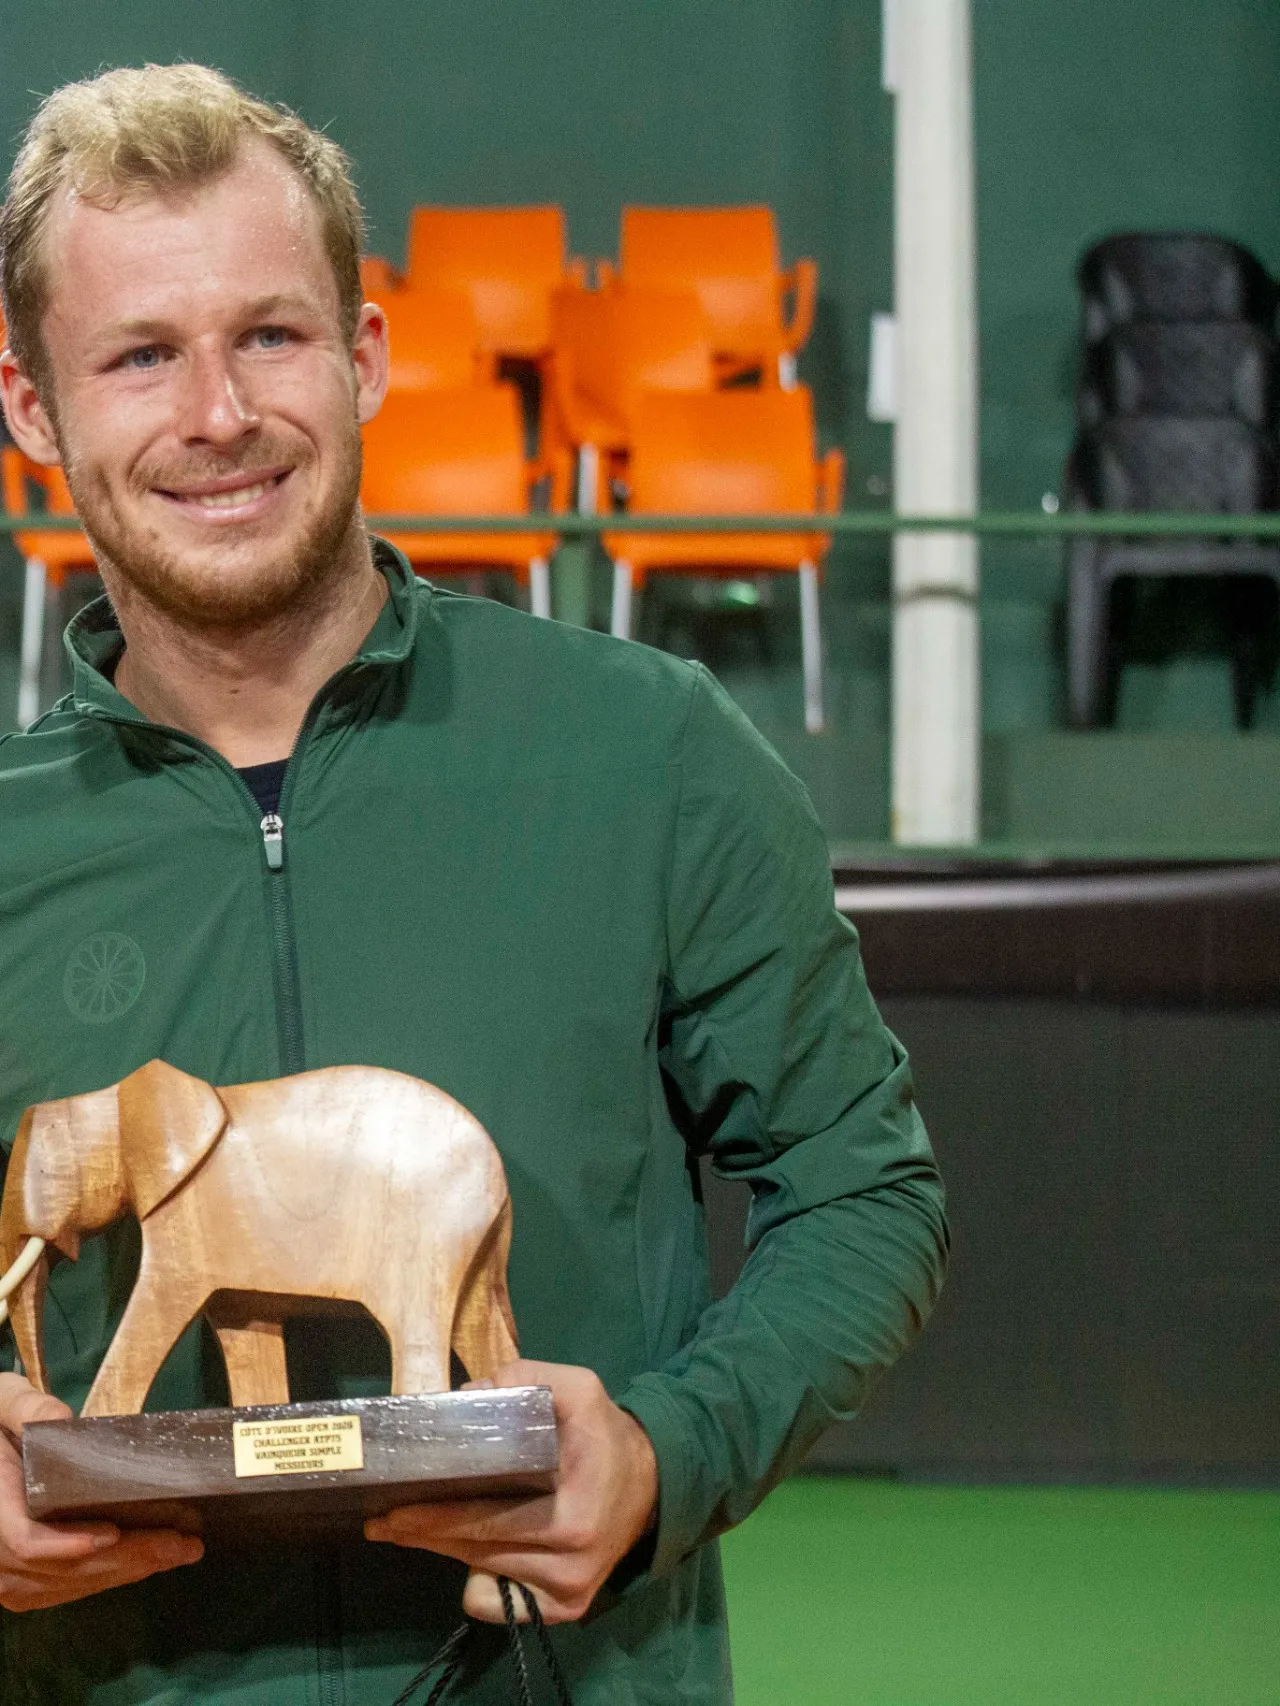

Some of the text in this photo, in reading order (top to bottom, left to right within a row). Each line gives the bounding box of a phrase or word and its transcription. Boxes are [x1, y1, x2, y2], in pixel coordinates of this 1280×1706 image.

[239, 1427, 262, 1437] CÔTE
[306, 1423, 328, 1432] OPEN
[253, 1436, 310, 1448] CHALLENGER
[255, 1446, 342, 1460] VAINQUEUR SIMPLE
[274, 1459, 324, 1470] MESSIEURS
